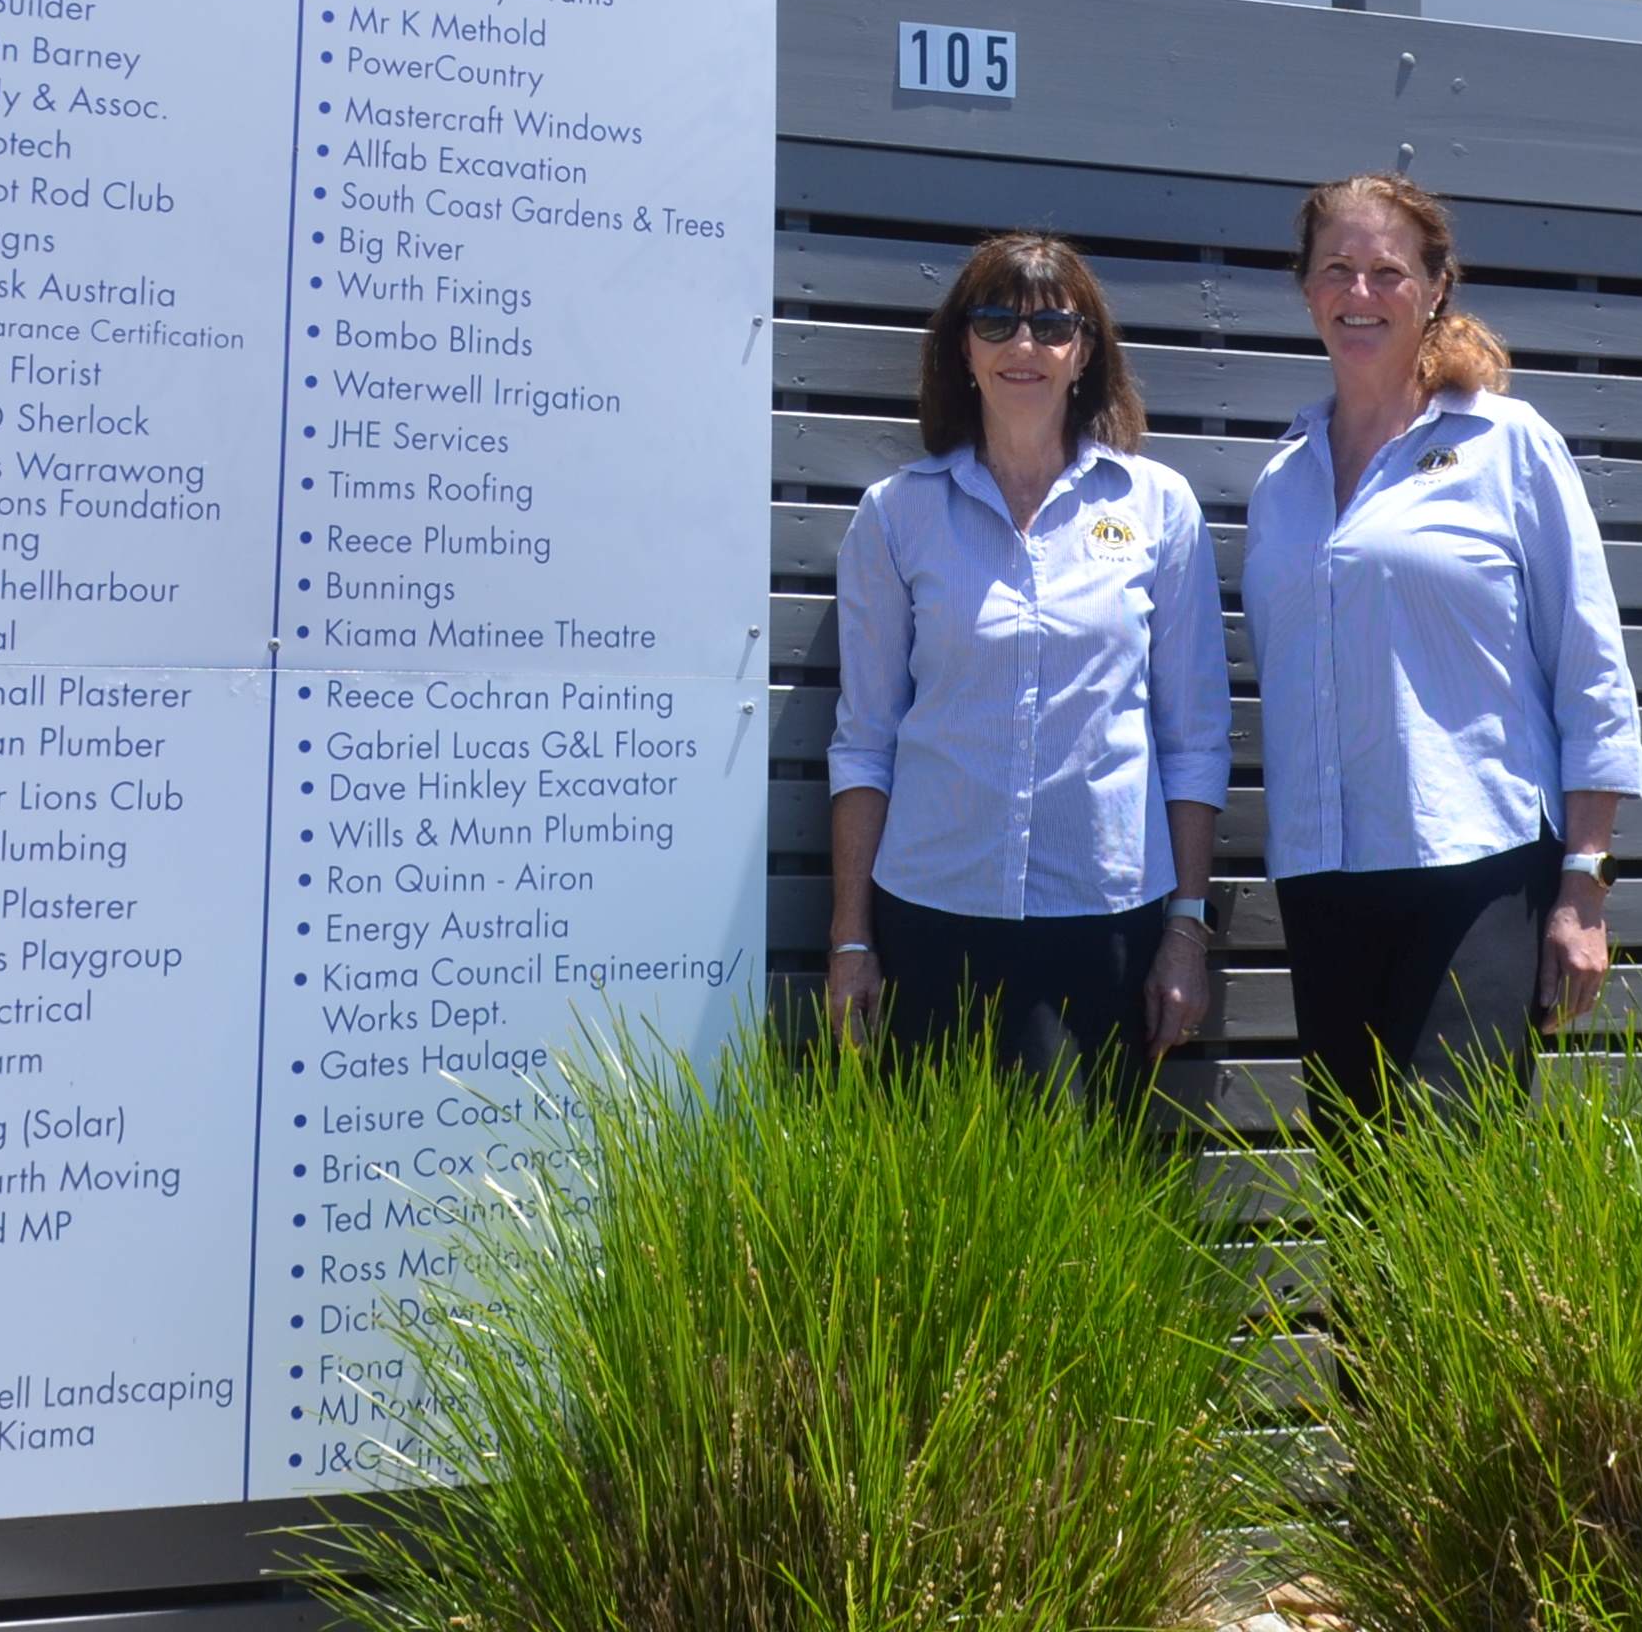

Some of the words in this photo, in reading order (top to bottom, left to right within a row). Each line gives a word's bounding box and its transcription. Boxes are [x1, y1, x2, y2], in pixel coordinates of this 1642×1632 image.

[349, 6, 390, 34] Mr
[402, 10, 420, 37] K
[432, 13, 545, 47] Methold
[33, 36, 141, 79] Barney
[349, 46, 544, 97] PowerCountry
[911, 29, 1008, 92] 105
[33, 83, 56, 112] &
[68, 86, 167, 119] Assoc.
[345, 97, 503, 134] Mastercraft
[514, 109, 642, 144] Windows
[343, 138, 426, 171] Allfab
[440, 146, 586, 184] Excavation
[341, 182, 414, 213] South
[426, 189, 502, 220] Coast
[512, 196, 622, 230] Gardens
[633, 206, 652, 232] &
[662, 208, 724, 238] Trees
[340, 226, 383, 264] Big
[397, 230, 464, 261] River
[39, 273, 175, 307] Australia
[337, 271, 423, 301] Wurth
[437, 276, 531, 315] Fixings
[91, 319, 243, 349] Certification
[11, 353, 101, 386] Florist
[333, 370, 481, 404] Waterwell
[495, 378, 620, 416] Irrigation
[18, 402, 149, 436] Sherlock
[328, 419, 381, 449] JHE
[394, 422, 508, 453] Services
[60, 489, 220, 520] Foundation
[328, 471, 415, 500] Timms
[428, 472, 532, 511] Roofing
[328, 525, 412, 553] Reece
[425, 524, 550, 564] Plumbing
[327, 572, 455, 609] Bunnings
[326, 618, 416, 647] Kiama
[429, 619, 544, 648] Matinee
[555, 618, 655, 648] Theatre
[60, 675, 192, 708] Plasterer
[328, 680, 413, 709] Reece
[426, 680, 548, 710] Cochran
[563, 682, 673, 719] Painting
[40, 725, 165, 758] Plumber
[327, 729, 439, 760] Gabriel
[454, 731, 530, 759] Lucas
[542, 730, 604, 758] G&L
[616, 728, 697, 758] Floors
[21, 781, 97, 810] Lions
[111, 779, 183, 811] Club
[331, 773, 405, 801] Dave
[419, 768, 526, 808] Hinkley
[539, 770, 677, 797] Excavator
[329, 817, 403, 848] Wills
[416, 818, 438, 847] &
[450, 818, 531, 846] Munn
[546, 812, 672, 850] Plumbing
[3, 887, 138, 919] Plasterer
[327, 914, 429, 950] Energy
[441, 908, 568, 939] Australia
[22, 939, 182, 979] Playgroup
[324, 963, 418, 992] Kiama
[432, 953, 541, 986] Council
[322, 1000, 418, 1034] Works
[432, 1000, 506, 1035] Dept.
[24, 1105, 124, 1148] (Solar)
[60, 1161, 180, 1197] Moving
[45, 1371, 233, 1411] Landscaping
